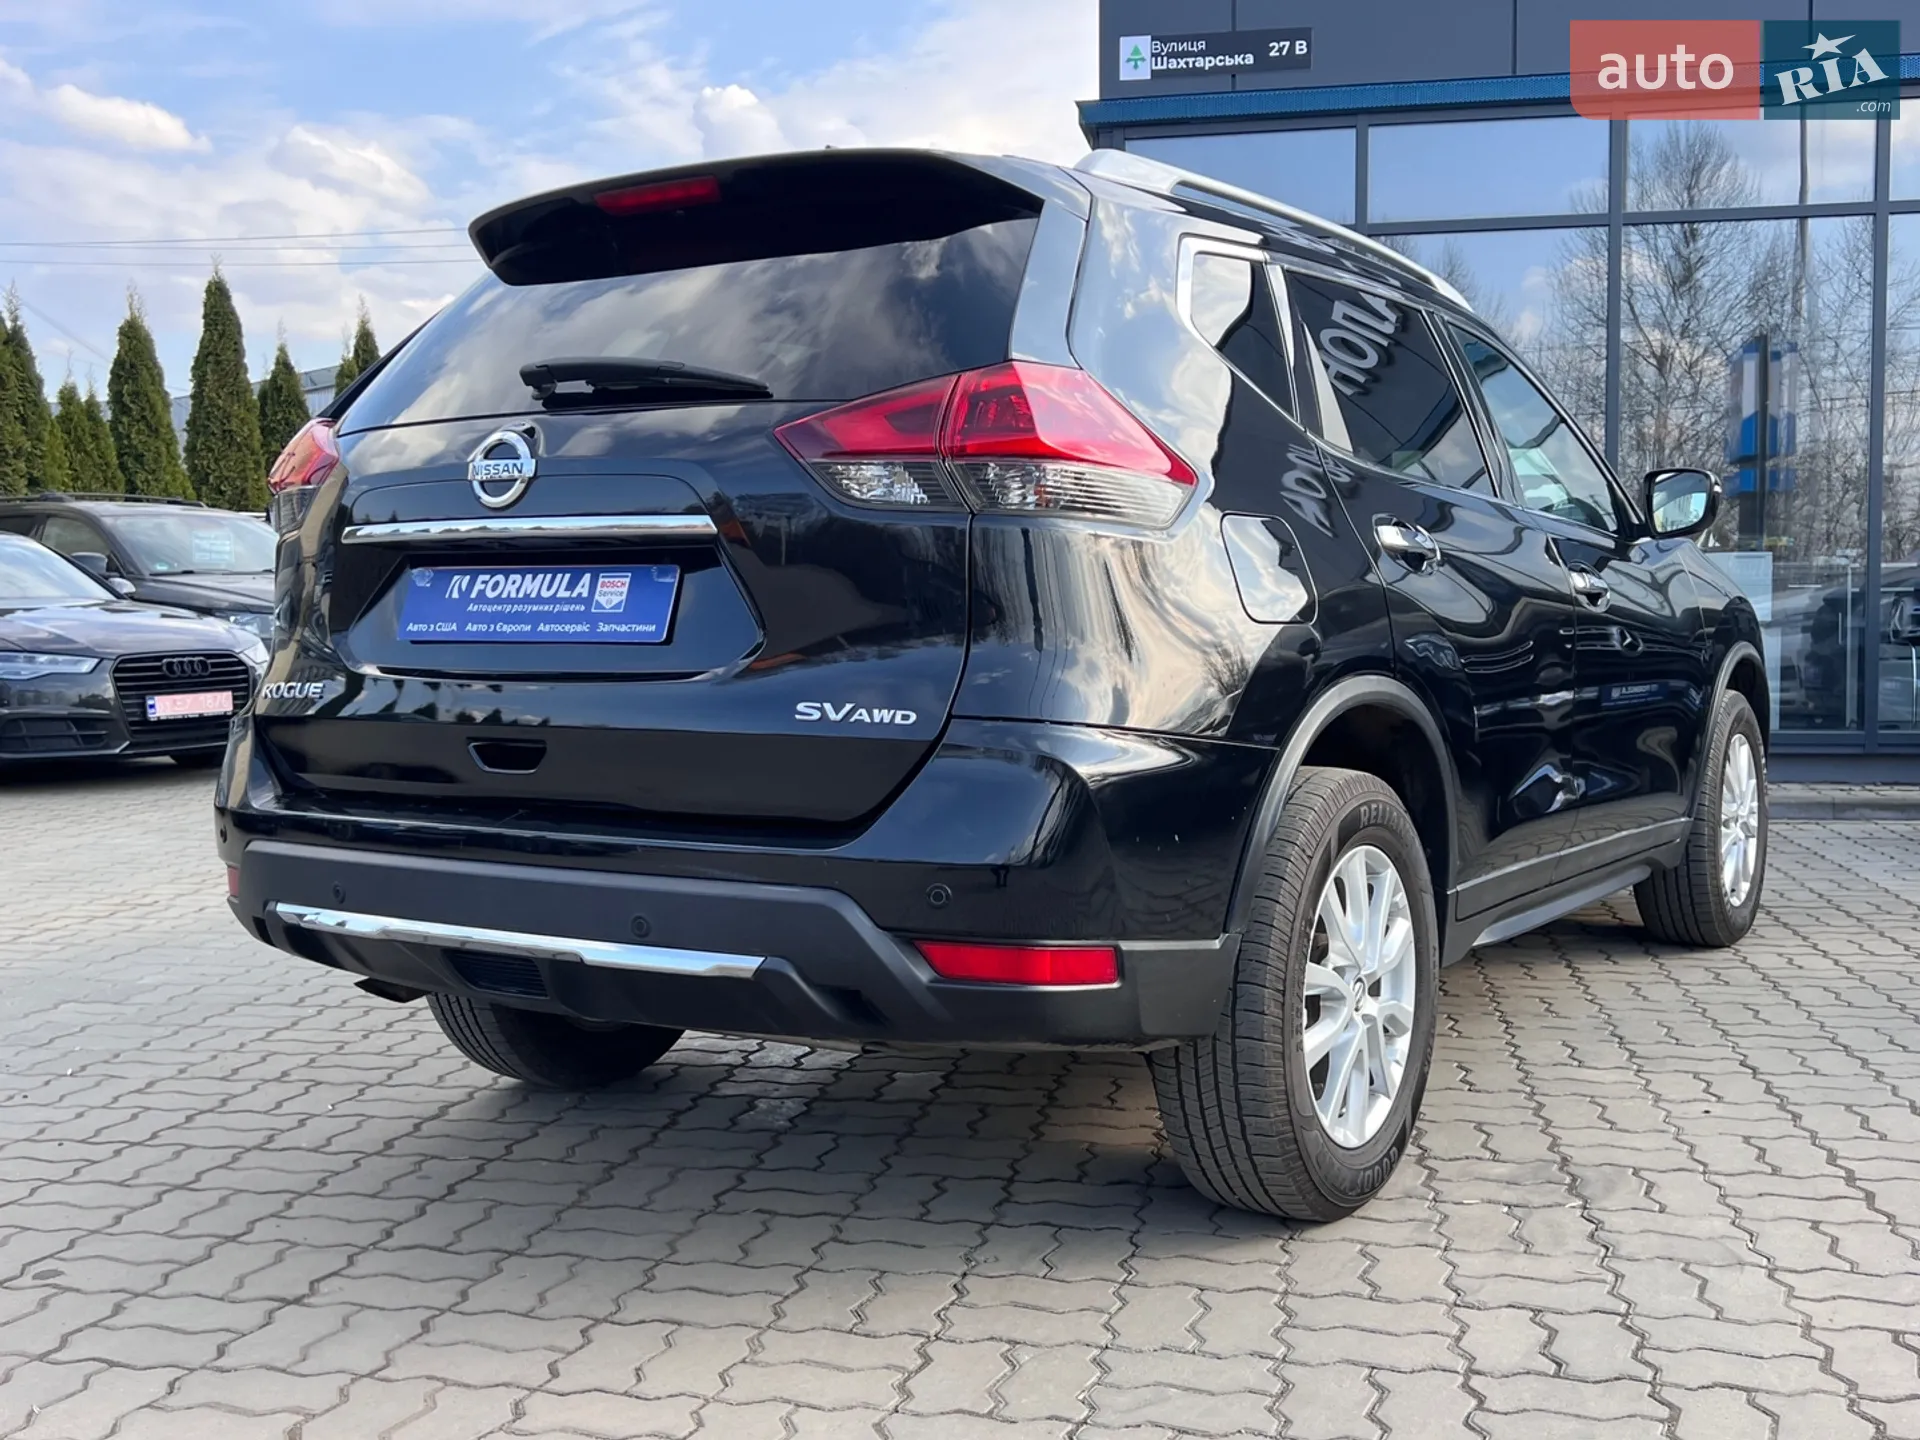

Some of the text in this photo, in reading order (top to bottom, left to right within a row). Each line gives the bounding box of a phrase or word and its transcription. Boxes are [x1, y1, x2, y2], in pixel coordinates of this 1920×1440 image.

[1151, 40, 1206, 55] Вулиця
[1268, 41, 1290, 57] 27
[1151, 53, 1255, 70] Шахтарська
[473, 462, 524, 476] NISSAN
[469, 573, 592, 599] FORMULA
[599, 580, 627, 589] BOSCH
[597, 589, 625, 597] Service
[466, 601, 586, 614] Автоцентр розумних рішень
[406, 622, 427, 632] Авто
[435, 622, 458, 632] США
[465, 622, 488, 632] Авто
[496, 622, 532, 634] Європи
[537, 621, 591, 634] Автосервіс
[596, 622, 657, 632] Запчастини
[262, 682, 324, 699] ROGUE
